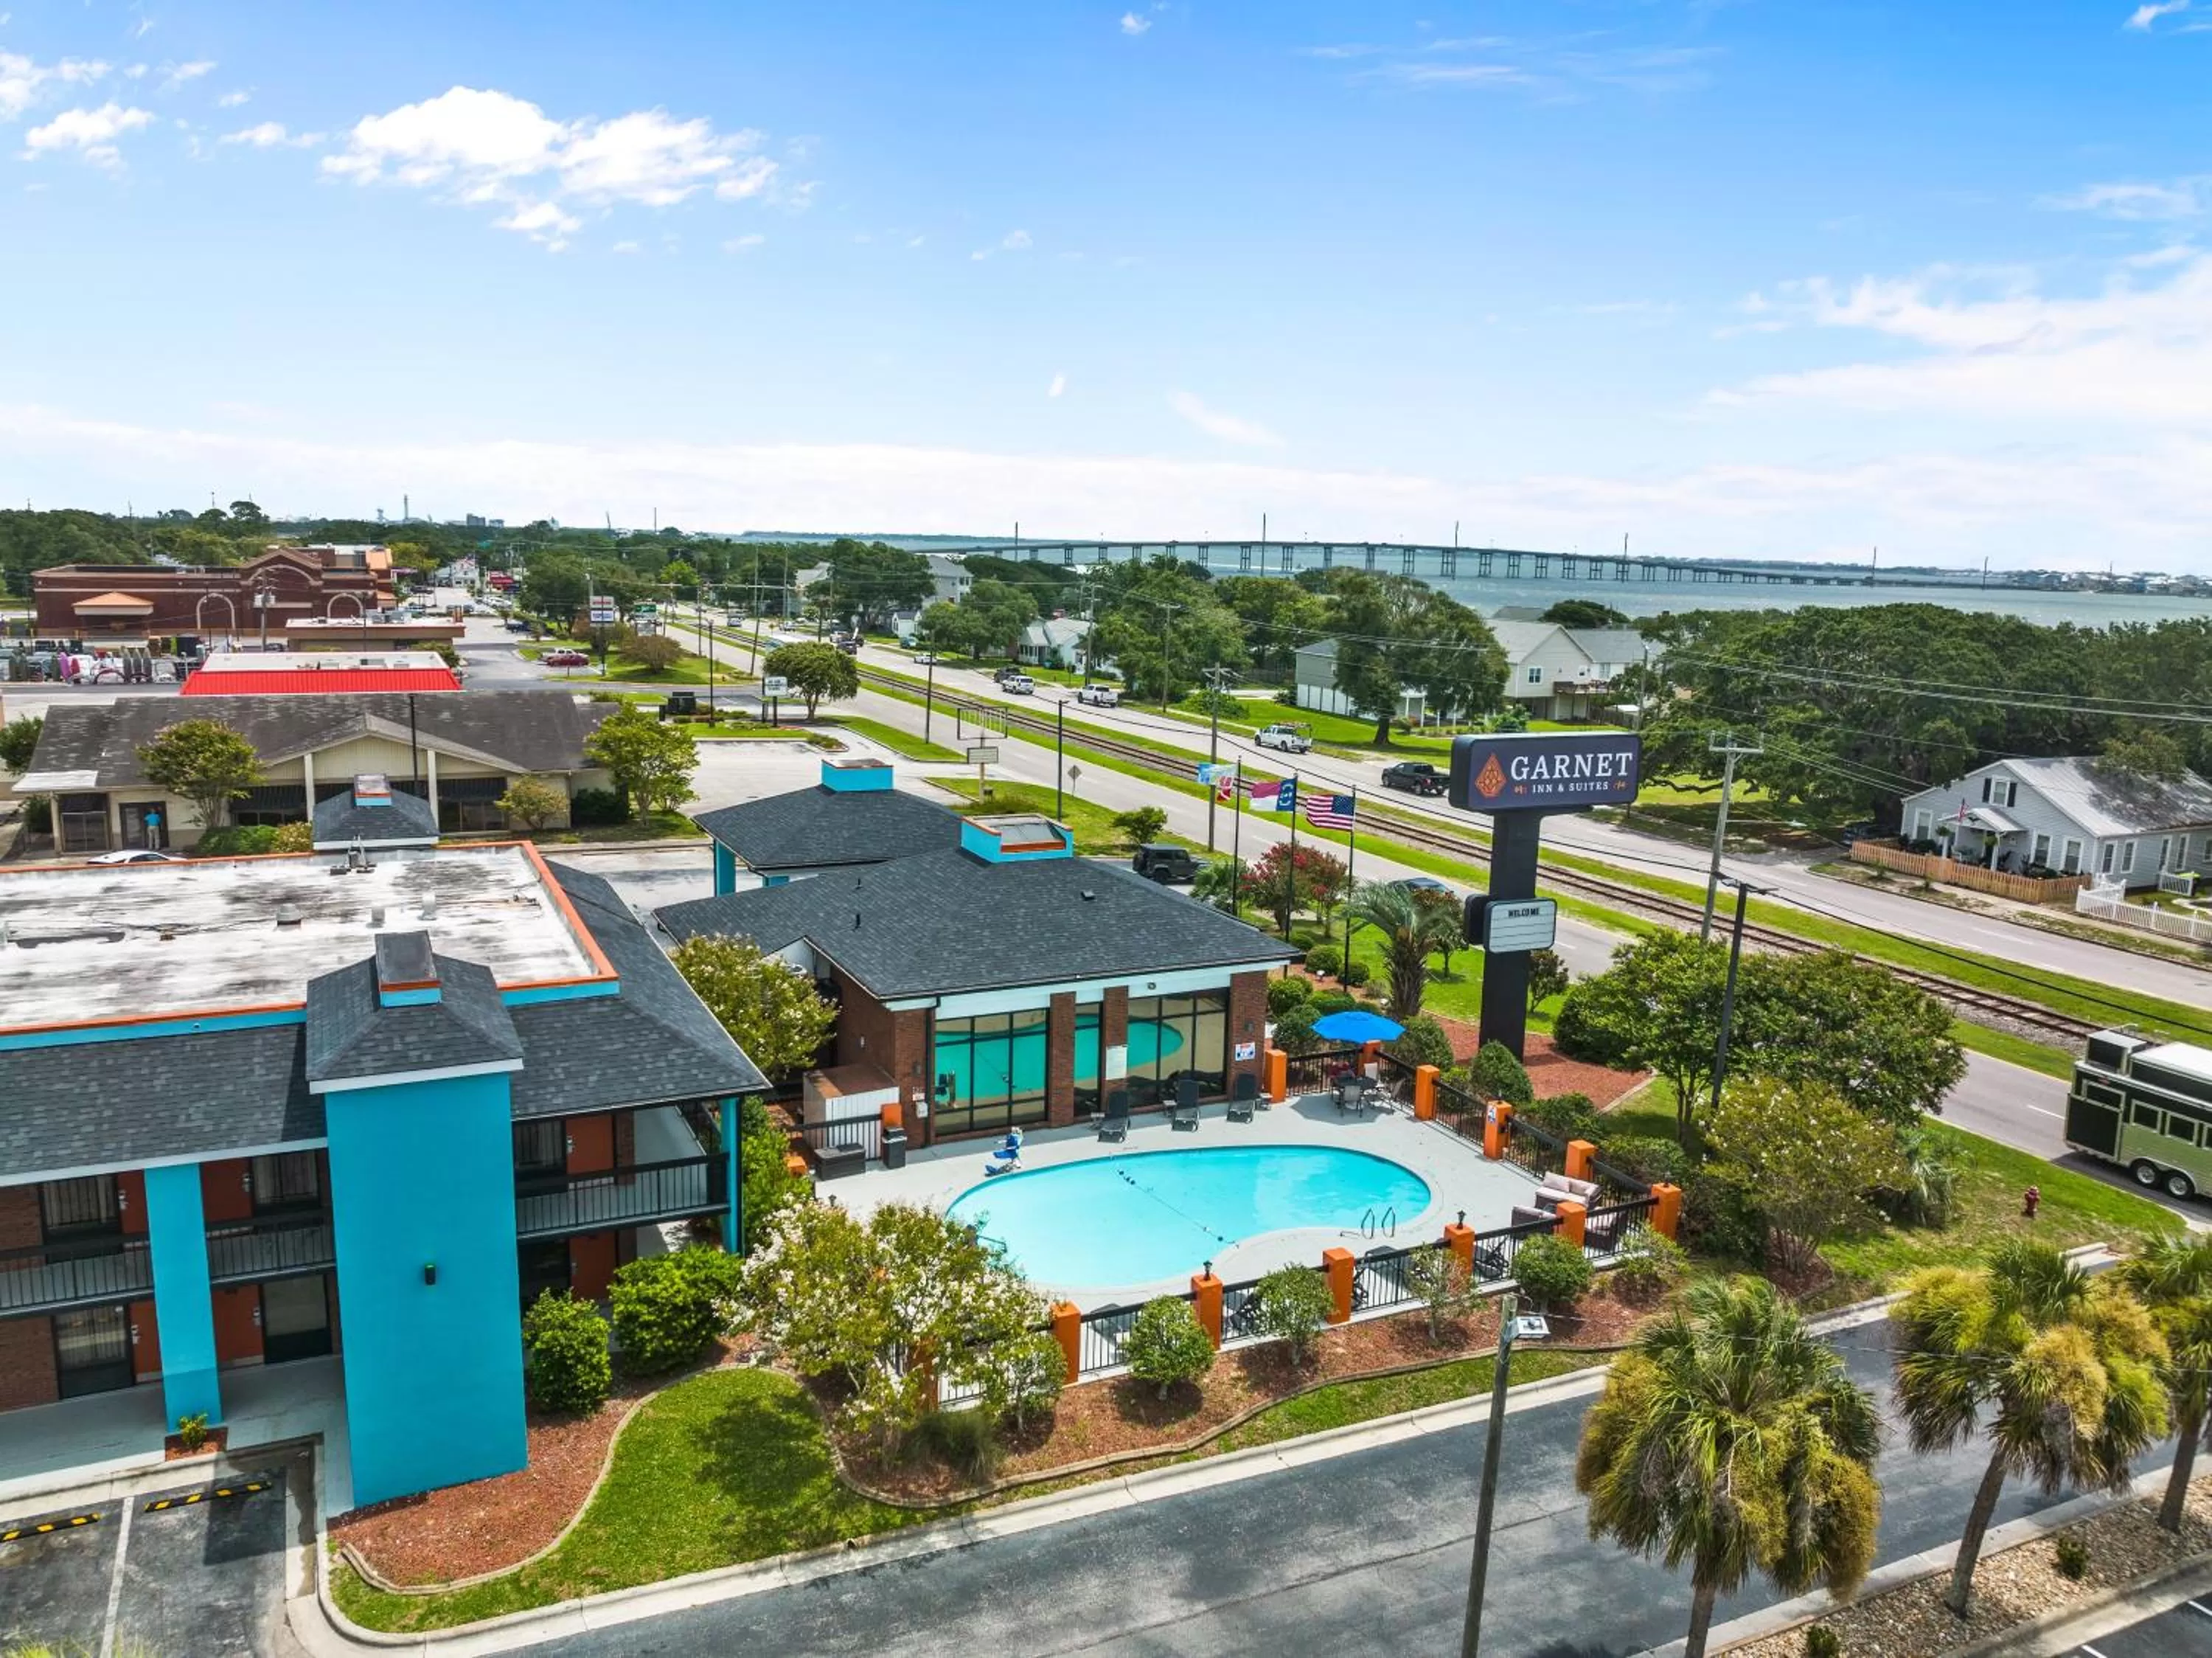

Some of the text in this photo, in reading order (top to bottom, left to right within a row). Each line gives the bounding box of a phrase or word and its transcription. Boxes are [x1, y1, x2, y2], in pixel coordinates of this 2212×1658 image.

[1511, 752, 1632, 780] GARNET
[1532, 781, 1609, 793] INN & SUITES
[1509, 908, 1540, 918] WELCOME
